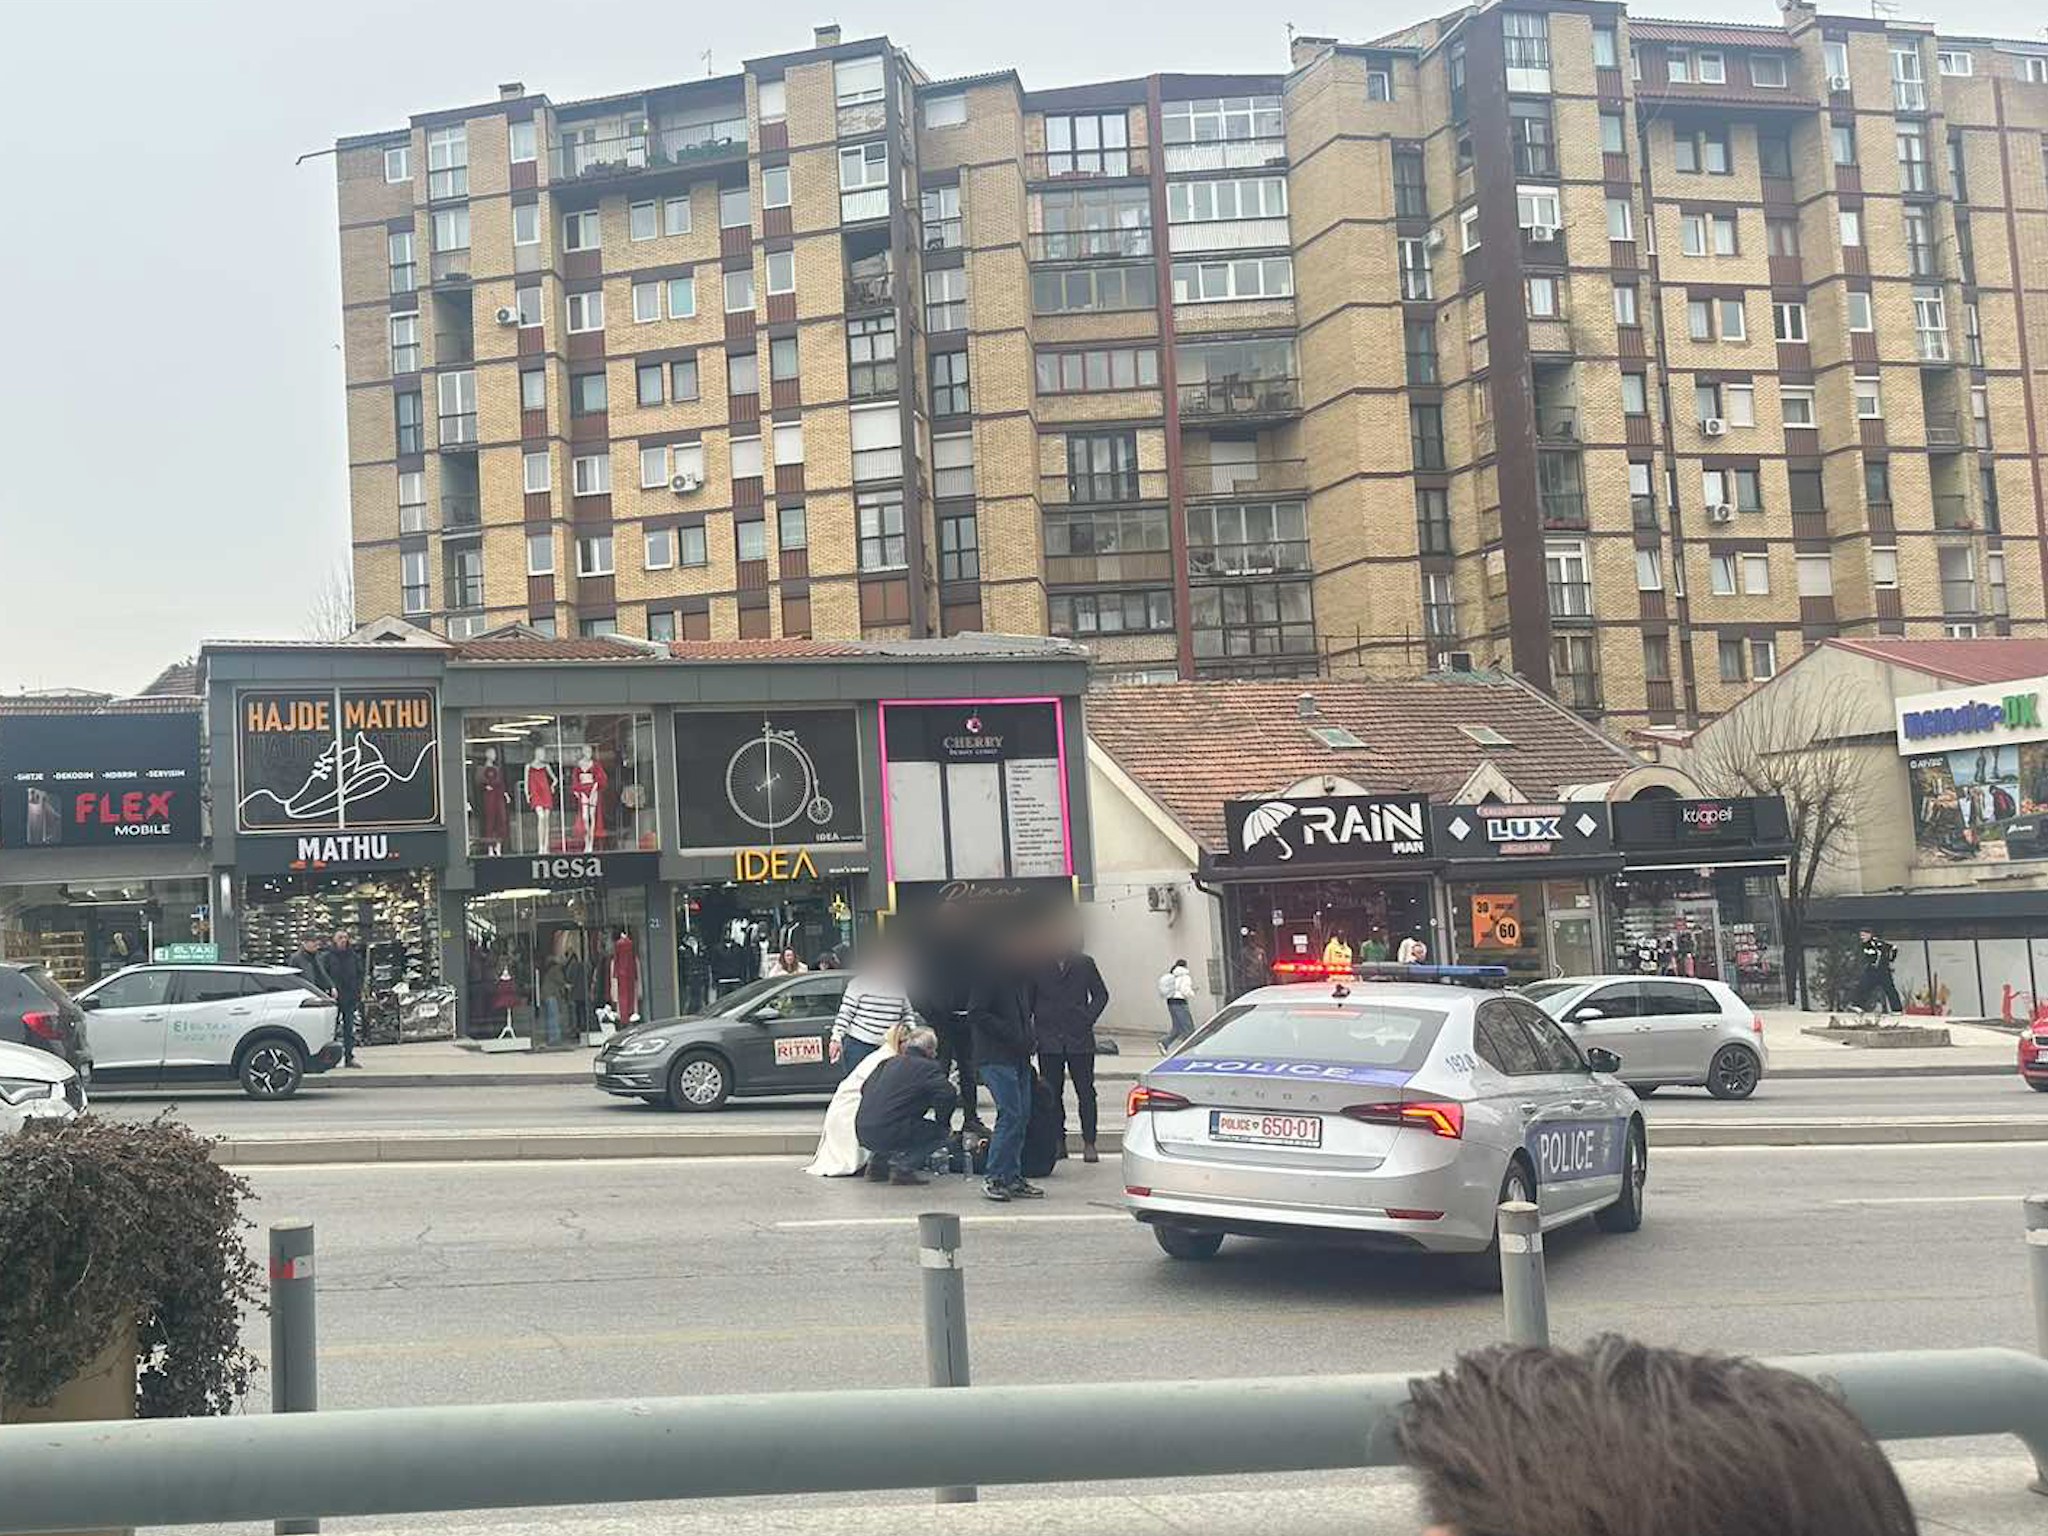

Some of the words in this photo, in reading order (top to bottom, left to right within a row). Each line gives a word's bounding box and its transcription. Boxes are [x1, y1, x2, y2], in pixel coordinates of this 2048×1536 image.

[248, 701, 331, 732] HAJDE
[344, 699, 428, 729] MATHU
[943, 736, 1004, 749] CHERRY
[75, 791, 176, 824] FLEX
[115, 824, 171, 836] MOBILE
[1300, 802, 1424, 845] RAIN
[1488, 817, 1562, 841] LUX
[815, 832, 840, 841] IDEA
[298, 835, 388, 861] MATHU
[1392, 842, 1424, 855] MAN
[531, 858, 604, 879] nesa
[736, 848, 818, 881] IDEA
[1477, 901, 1489, 913] 30
[1499, 923, 1516, 938] 60
[778, 1044, 820, 1057] RITMI
[1183, 1060, 1354, 1080] POLICE
[1220, 1118, 1251, 1131] POLICE
[1540, 1130, 1595, 1176] POLICE
